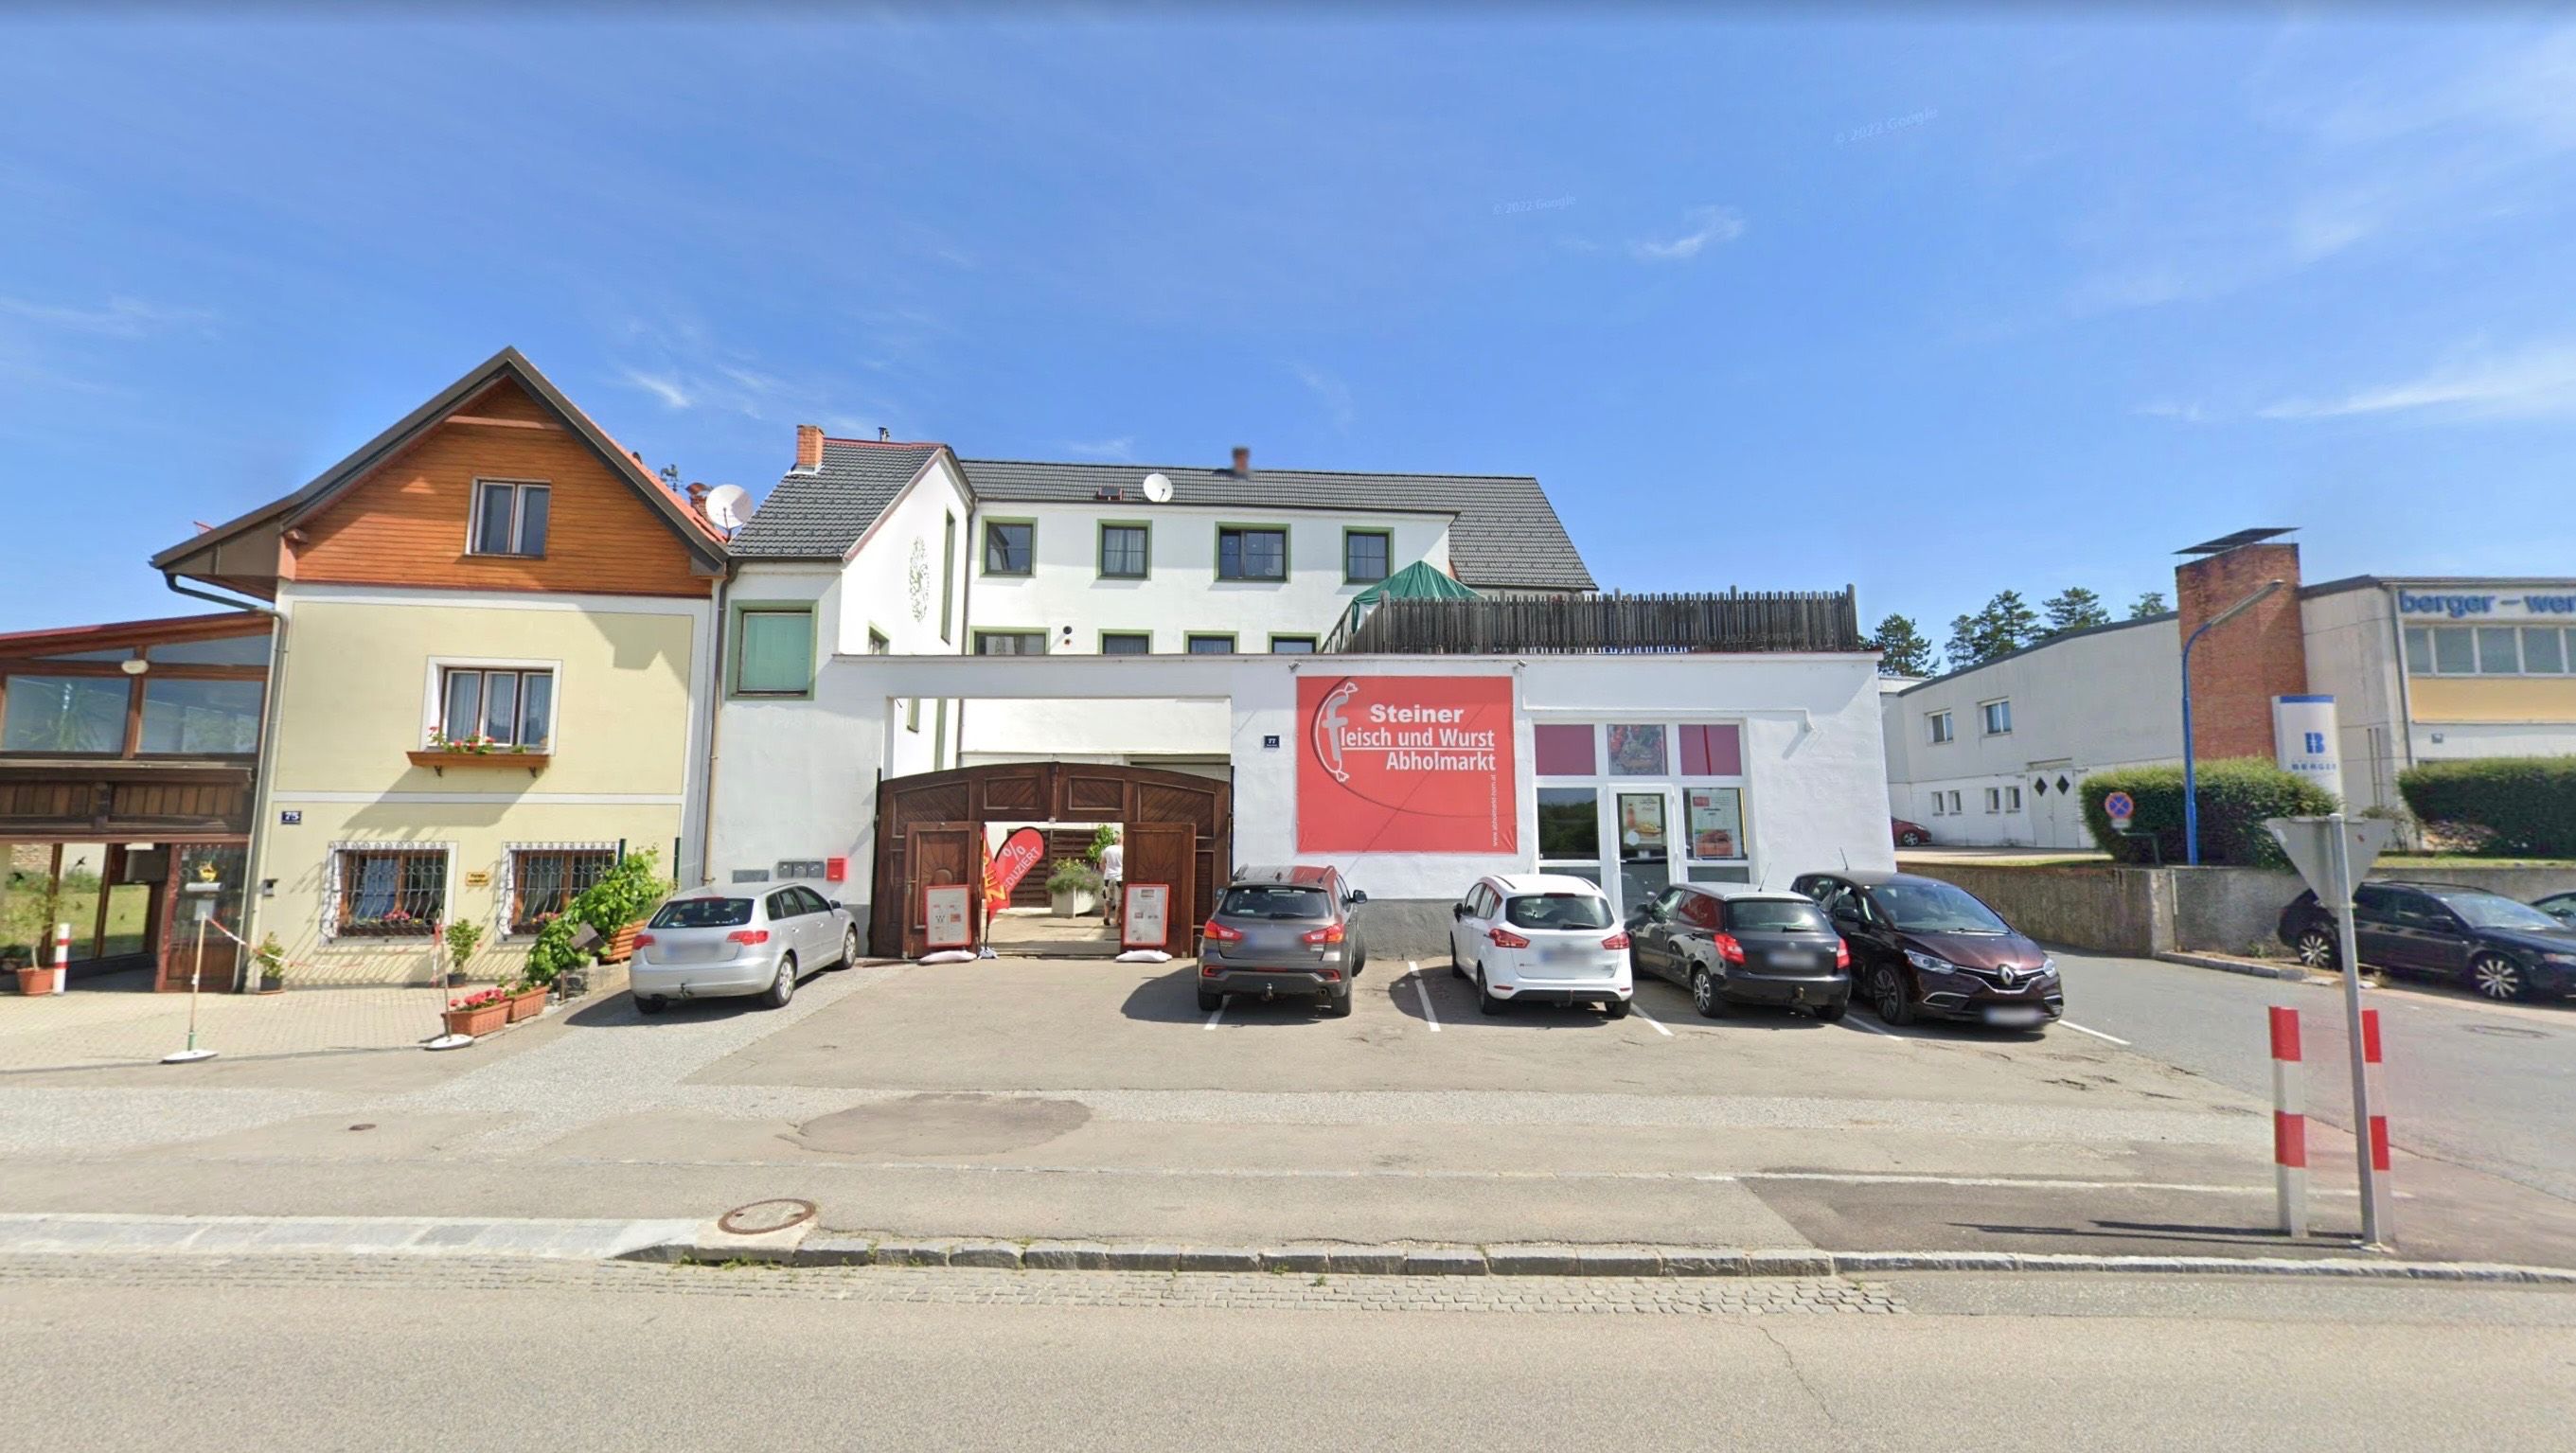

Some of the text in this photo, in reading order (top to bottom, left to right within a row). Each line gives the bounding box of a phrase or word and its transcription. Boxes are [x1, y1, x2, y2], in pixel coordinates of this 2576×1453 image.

[2399, 590, 2496, 618] berger
[1370, 703, 1465, 724] Steiner
[1397, 727, 1433, 747] und
[1439, 729, 1496, 748] Wurst
[1386, 751, 1497, 771] Abholmarkt
[284, 811, 299, 821] 75
